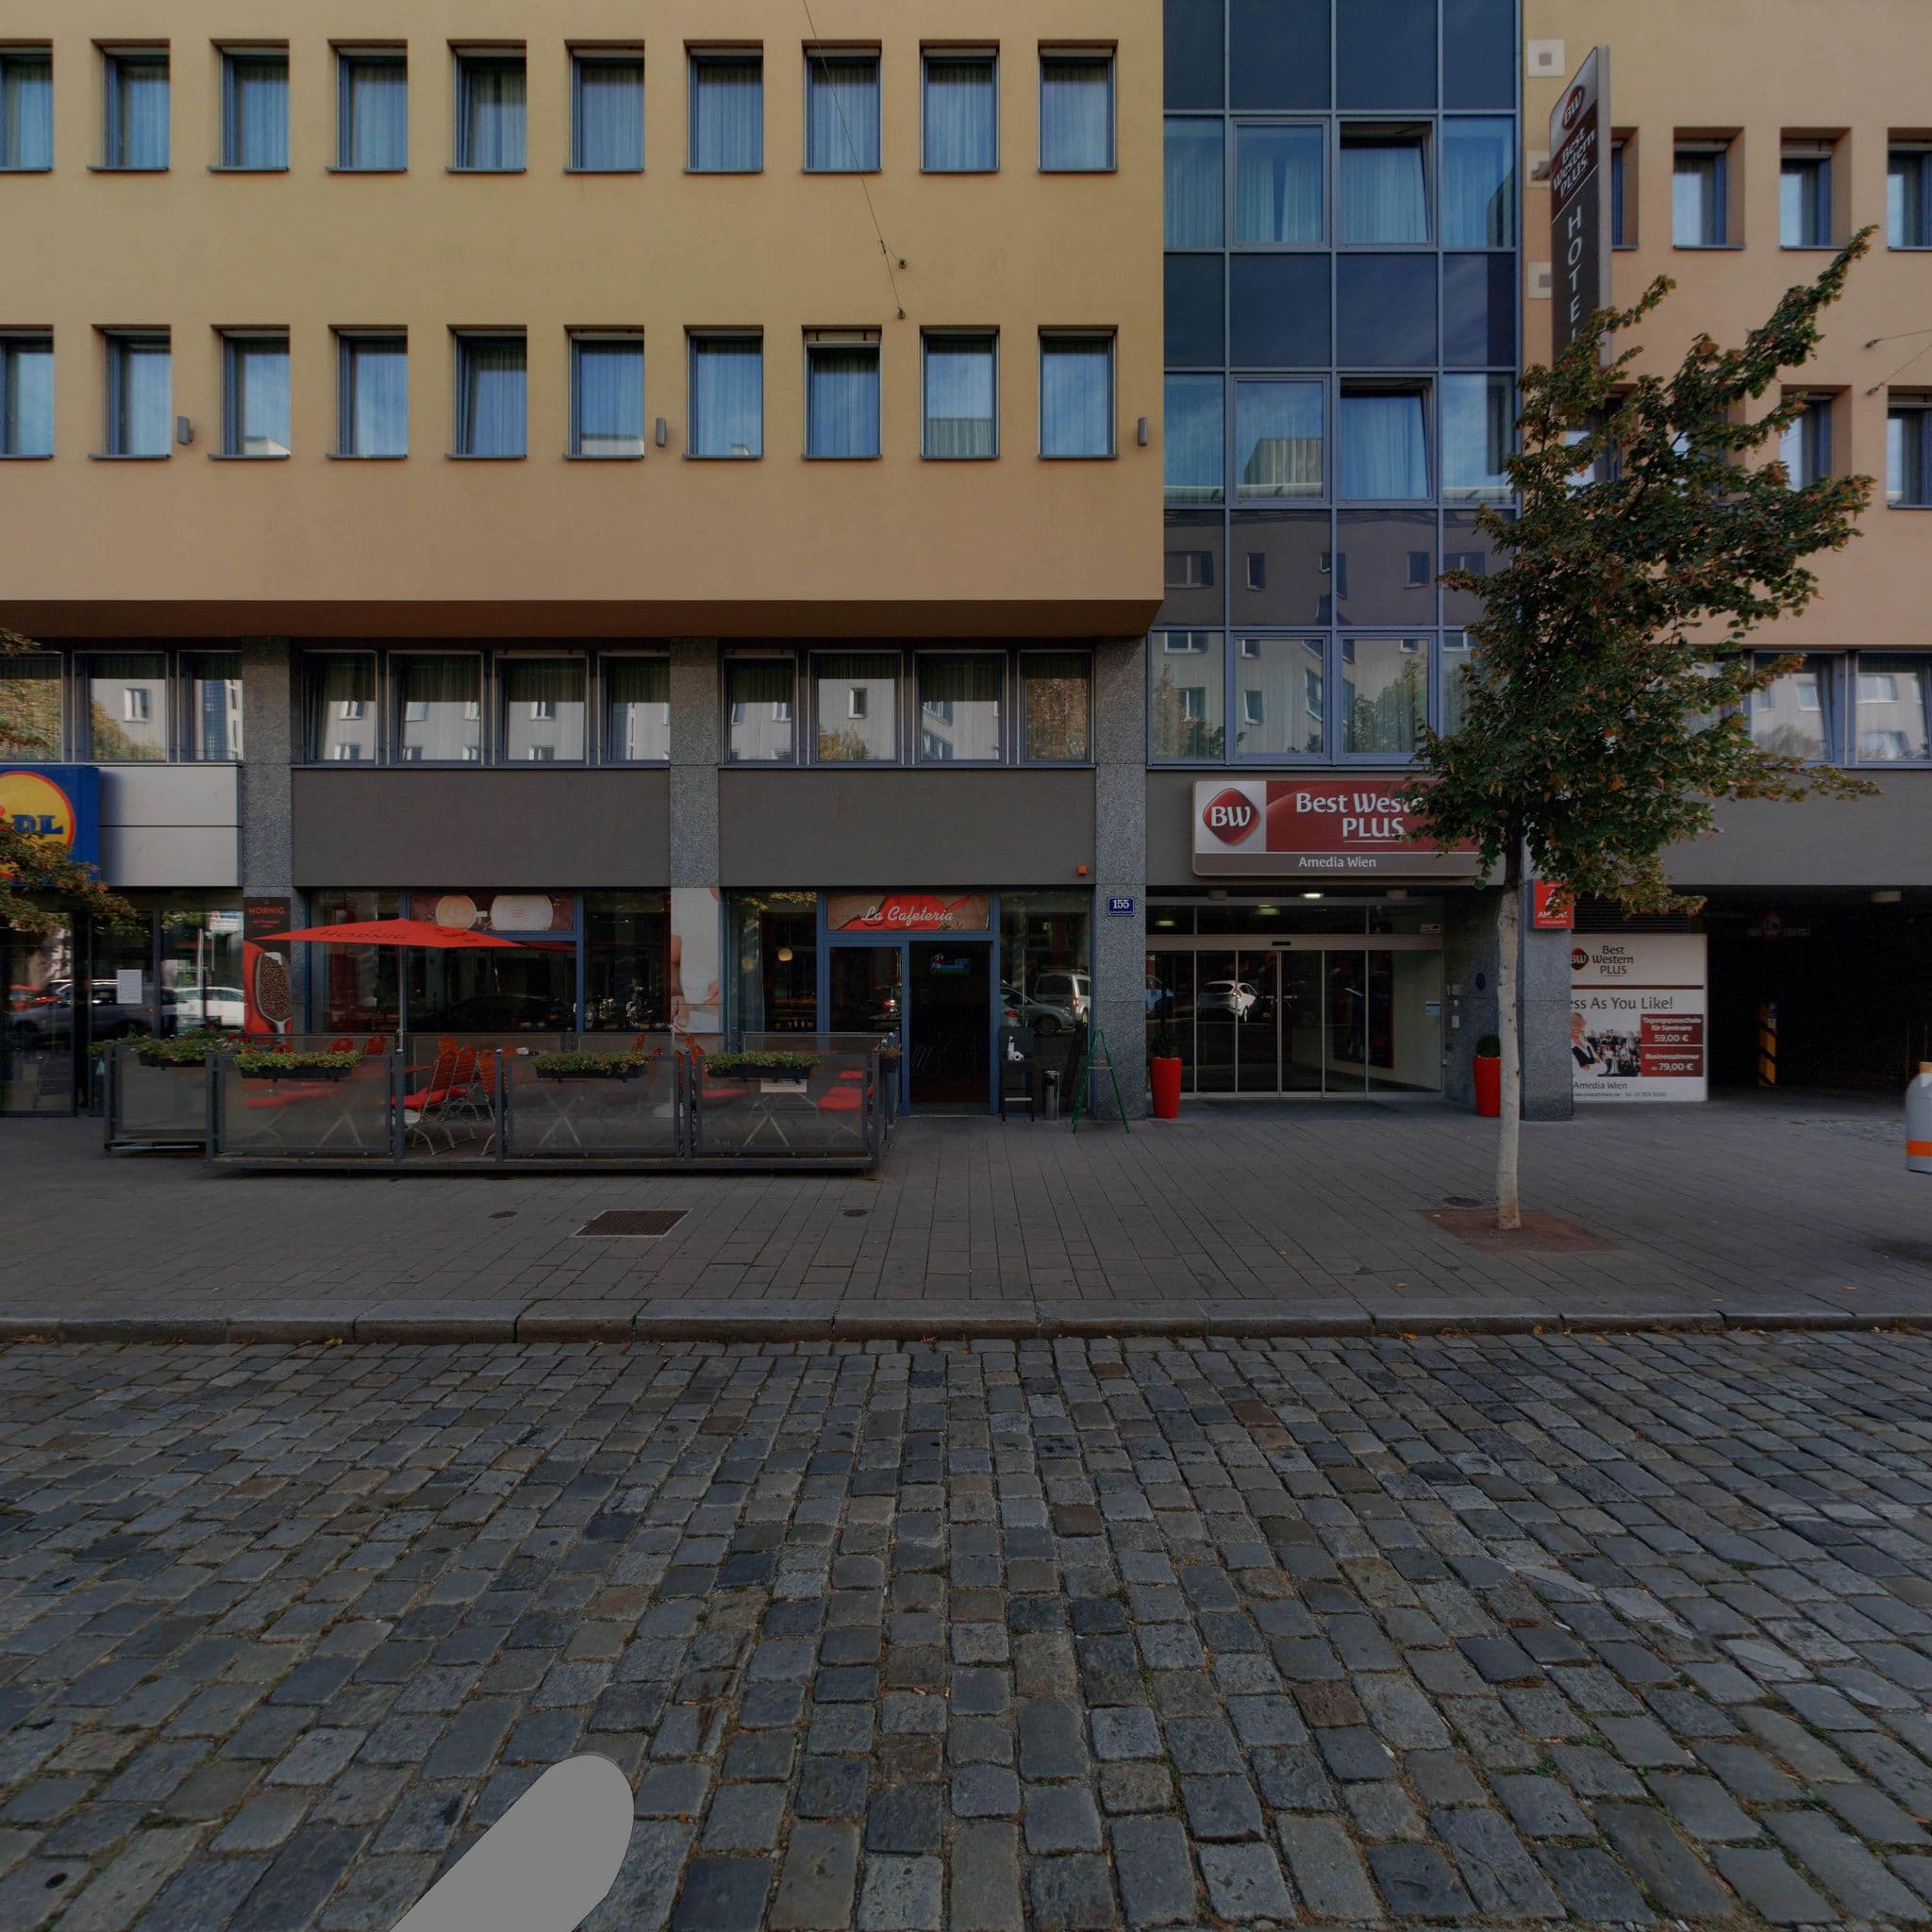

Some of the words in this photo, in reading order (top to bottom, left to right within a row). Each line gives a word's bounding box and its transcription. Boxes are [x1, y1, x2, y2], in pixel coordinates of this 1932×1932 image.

[1562, 126, 1586, 166] Best
[1553, 128, 1596, 191] Western
[1560, 152, 1589, 198] PLUS
[1296, 792, 1348, 813] Best
[1210, 806, 1251, 827] BW
[1342, 817, 1405, 838] PLUS
[1298, 857, 1344, 868] Amedia
[1347, 857, 1376, 868] Wien
[1112, 899, 1130, 909] 155
[861, 906, 884, 922] La
[887, 906, 955, 926] Cafeteria
[1602, 945, 1625, 955] Best
[1592, 955, 1634, 964] Western
[1600, 965, 1627, 974] PLUS
[1591, 997, 1607, 1009] As
[1611, 997, 1637, 1009] You
[1641, 996, 1674, 1009] Like!
[1654, 1034, 1680, 1042] 59,00
[1682, 1034, 1690, 1042] €
[1658, 1062, 1685, 1072] 79,00
[1574, 1081, 1605, 1090] Amedia
[1607, 1081, 1627, 1090] Wien
